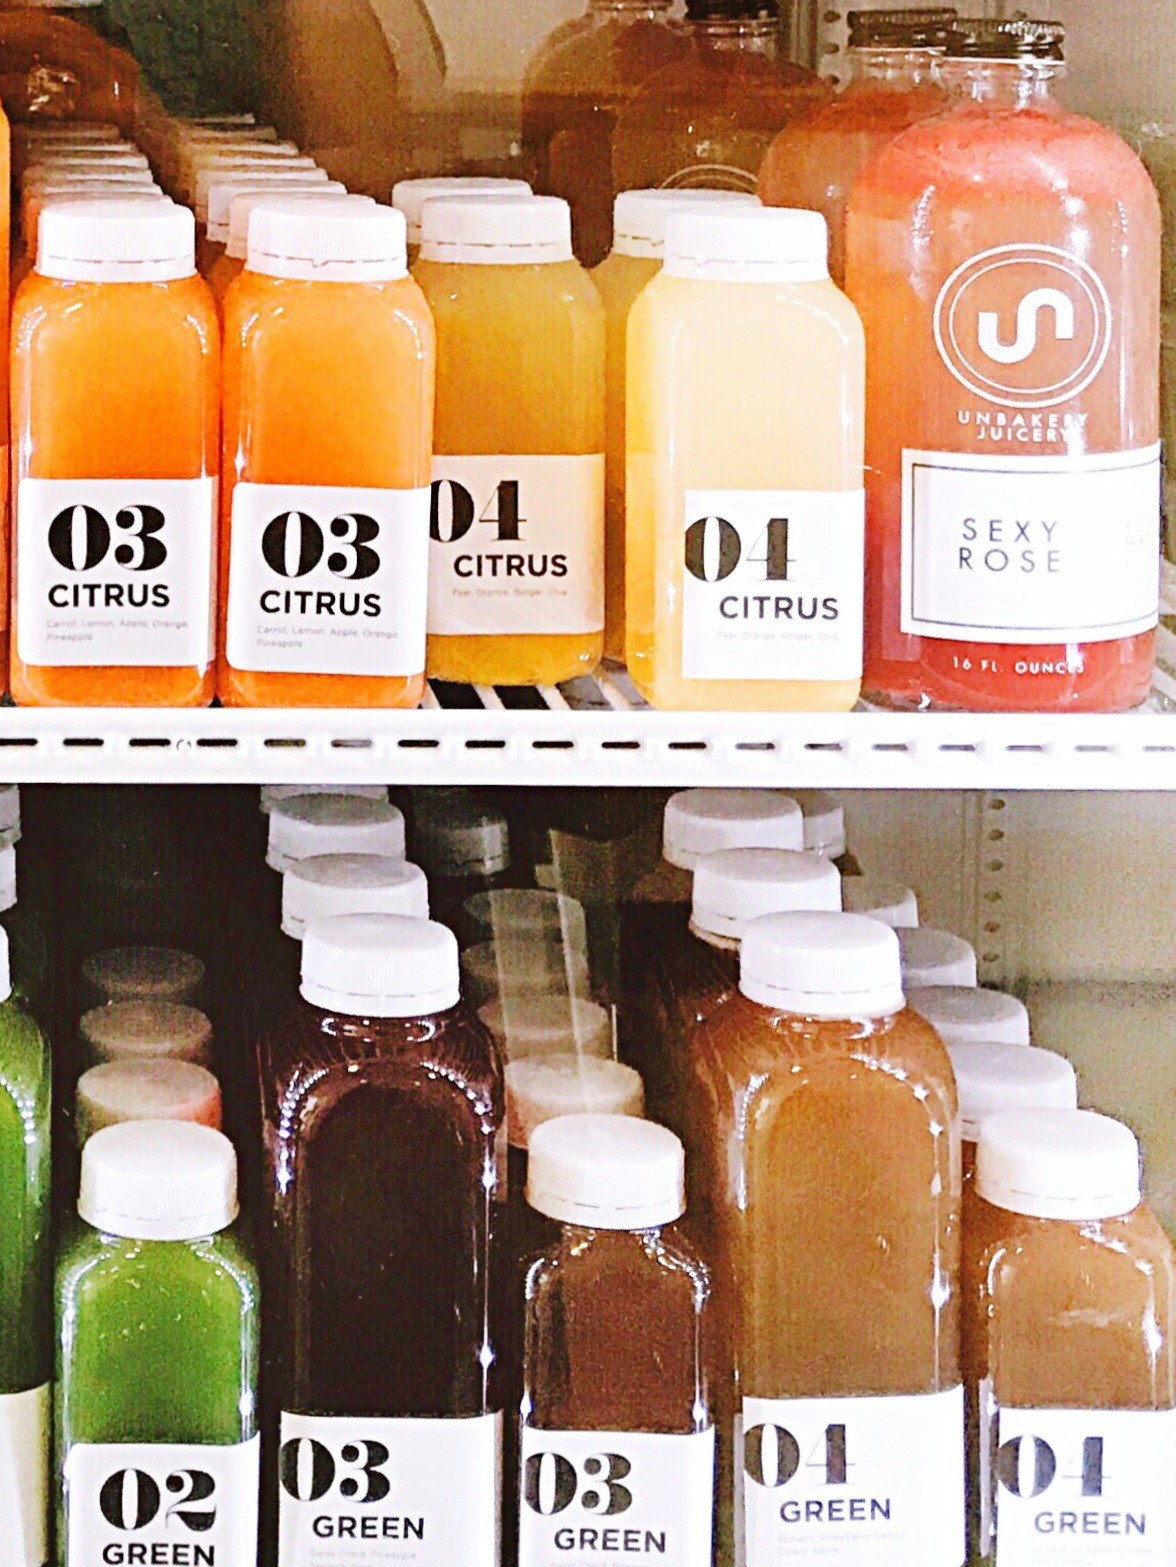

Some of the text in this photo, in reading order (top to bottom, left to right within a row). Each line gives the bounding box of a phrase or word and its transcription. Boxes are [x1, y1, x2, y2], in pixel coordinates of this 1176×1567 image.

[429, 479, 527, 543] 04
[48, 504, 168, 571] 03
[962, 517, 1060, 544] SEXY
[261, 511, 380, 580] 03
[685, 516, 797, 582] 04
[454, 554, 568, 578] CITRUS
[958, 547, 1061, 574] ROSE
[48, 584, 170, 608] CITRUS
[260, 590, 381, 617] CITRUS
[719, 596, 839, 620] CITRUS
[953, 656, 972, 671] 16
[744, 1423, 856, 1488] 04
[998, 1434, 1111, 1499] 04
[278, 1437, 391, 1503] 03
[524, 1452, 633, 1516] 03
[99, 1468, 217, 1532] 02
[780, 1498, 891, 1523] GREEN
[312, 1516, 425, 1540] GREEN
[1035, 1512, 1146, 1535] GREEN
[554, 1528, 666, 1553] GREEN
[103, 1543, 215, 1567] GREEN
